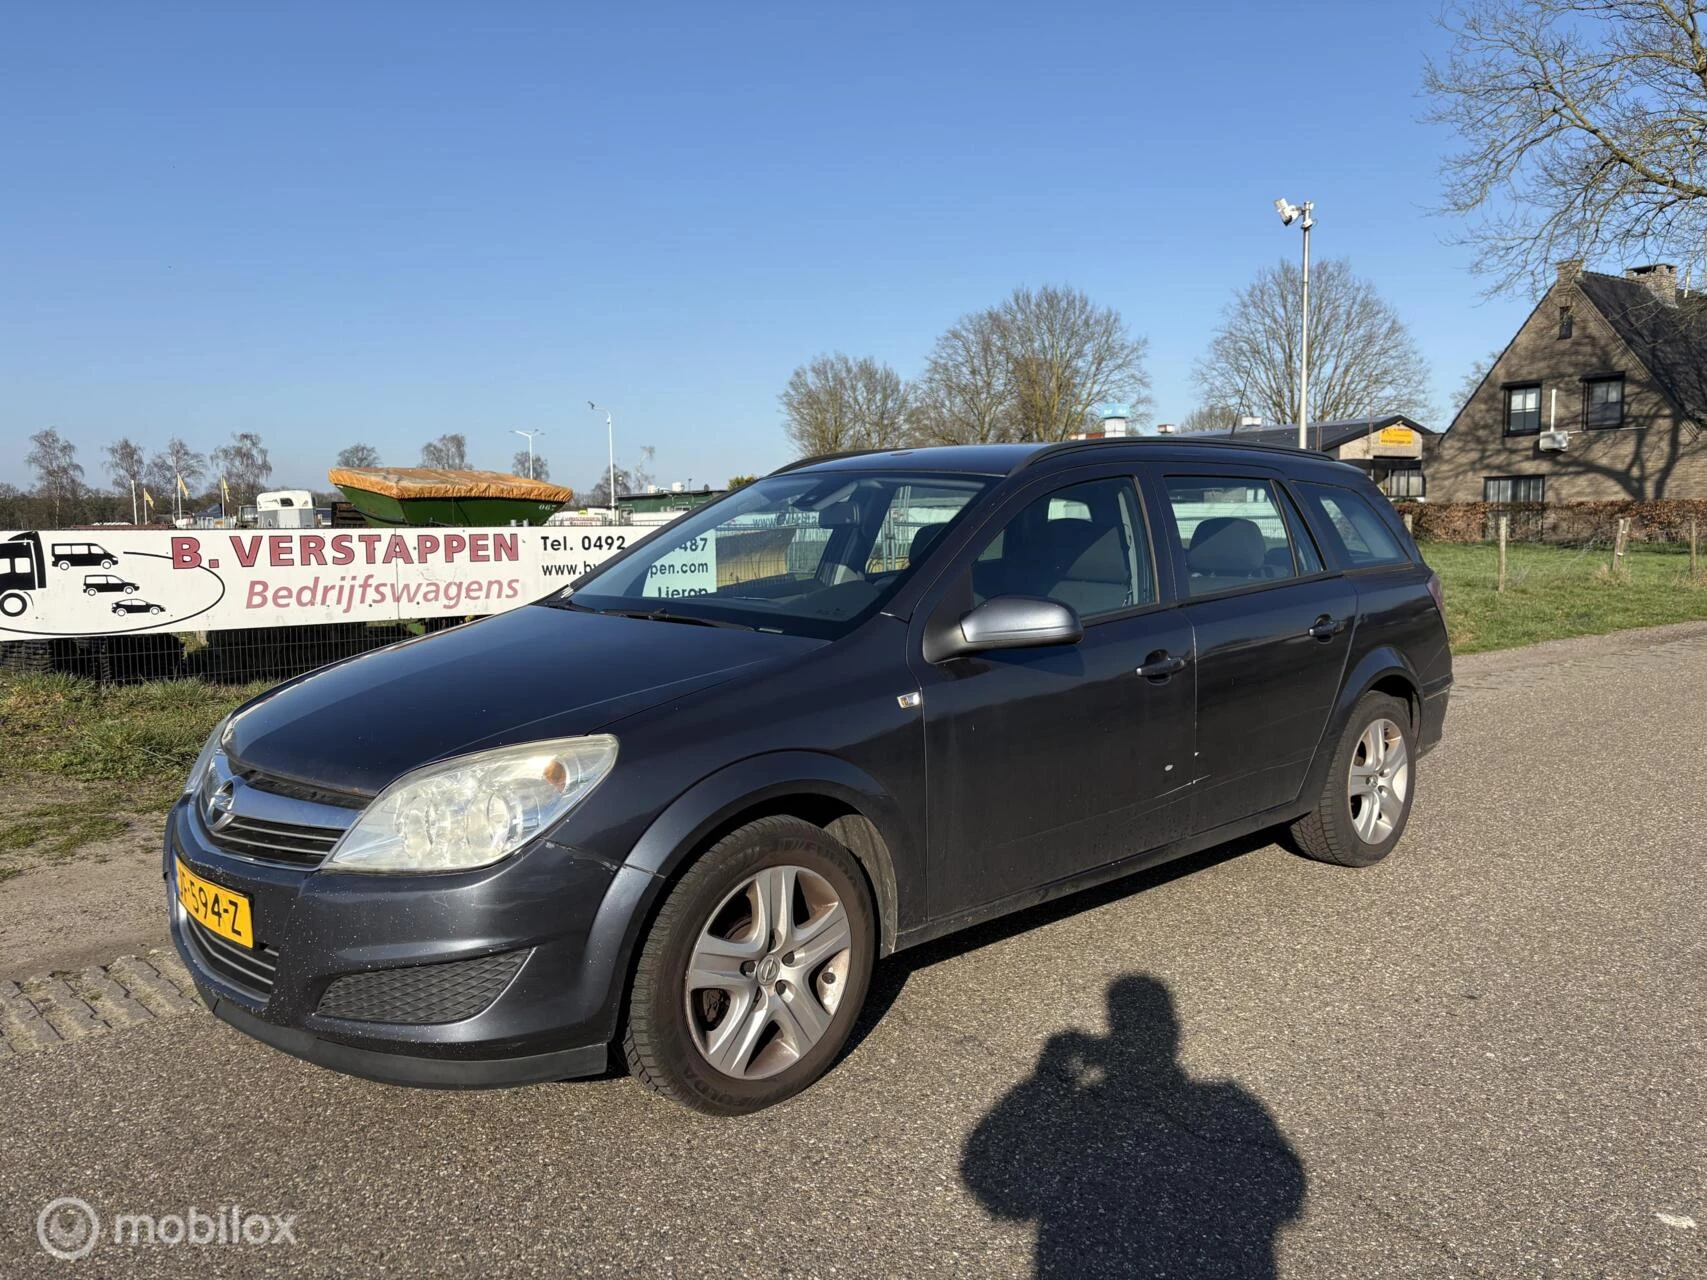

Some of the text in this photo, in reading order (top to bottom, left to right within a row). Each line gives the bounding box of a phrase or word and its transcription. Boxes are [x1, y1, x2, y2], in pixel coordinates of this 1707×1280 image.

[171, 533, 520, 570] B. VERSTAPPEN
[540, 535, 574, 551] Tel.
[581, 535, 626, 551] 0492
[245, 573, 520, 613] Bedrijfswagens
